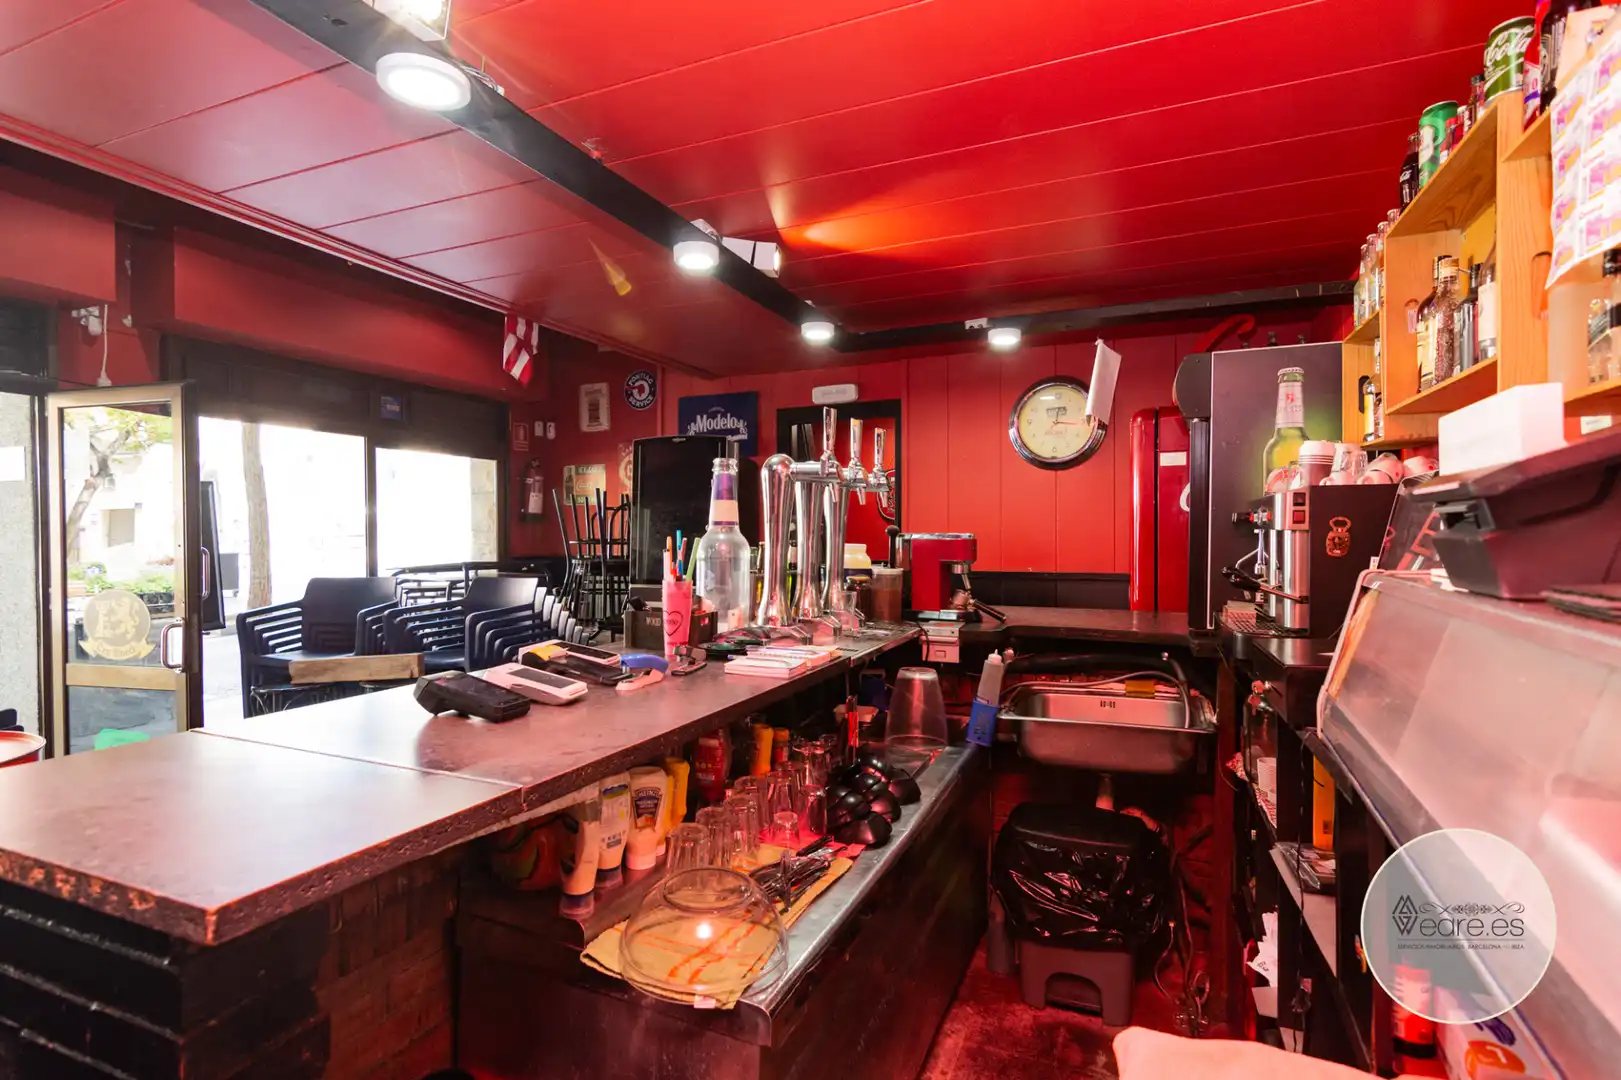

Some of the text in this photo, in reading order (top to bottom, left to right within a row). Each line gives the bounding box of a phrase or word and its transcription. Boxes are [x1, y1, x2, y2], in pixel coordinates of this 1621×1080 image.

[628, 372, 654, 386] PONTIAC
[628, 395, 654, 408] SERVICE
[696, 412, 738, 433] Modelo
